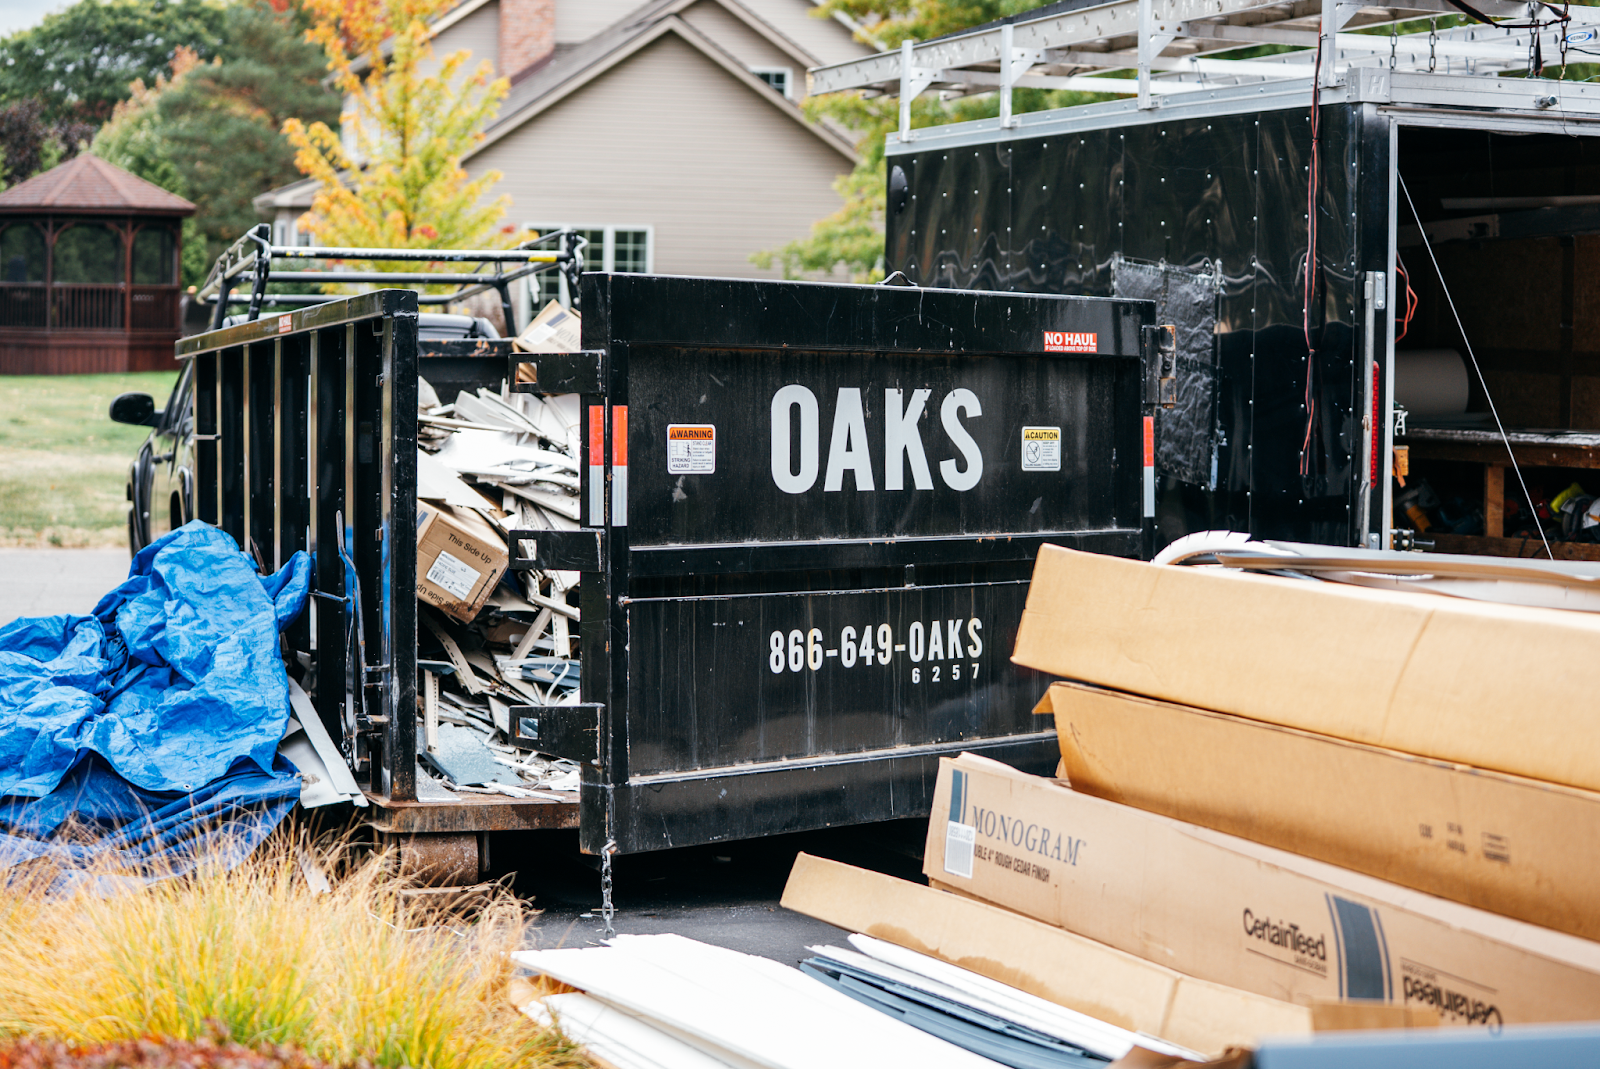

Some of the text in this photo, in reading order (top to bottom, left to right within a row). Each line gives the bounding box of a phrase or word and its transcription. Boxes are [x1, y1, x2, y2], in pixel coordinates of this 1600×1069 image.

[1045, 333, 1096, 346] NO HAUL
[676, 430, 712, 438] WARNING
[771, 384, 983, 494] OAKS
[1030, 431, 1058, 439] CAUTION
[448, 532, 491, 565] This Side Up
[417, 583, 427, 595] Up
[428, 591, 444, 604] Side
[444, 602, 459, 613] This
[769, 617, 983, 674] 866-649-OAKS
[972, 805, 1081, 867] MONOGRAM
[995, 851, 1013, 869] ROUGH
[1013, 857, 1032, 875] CEDAR
[1032, 863, 1051, 882] FINISH
[1243, 907, 1326, 961] CertainTeed
[1403, 975, 1503, 1038] CertainTeed
